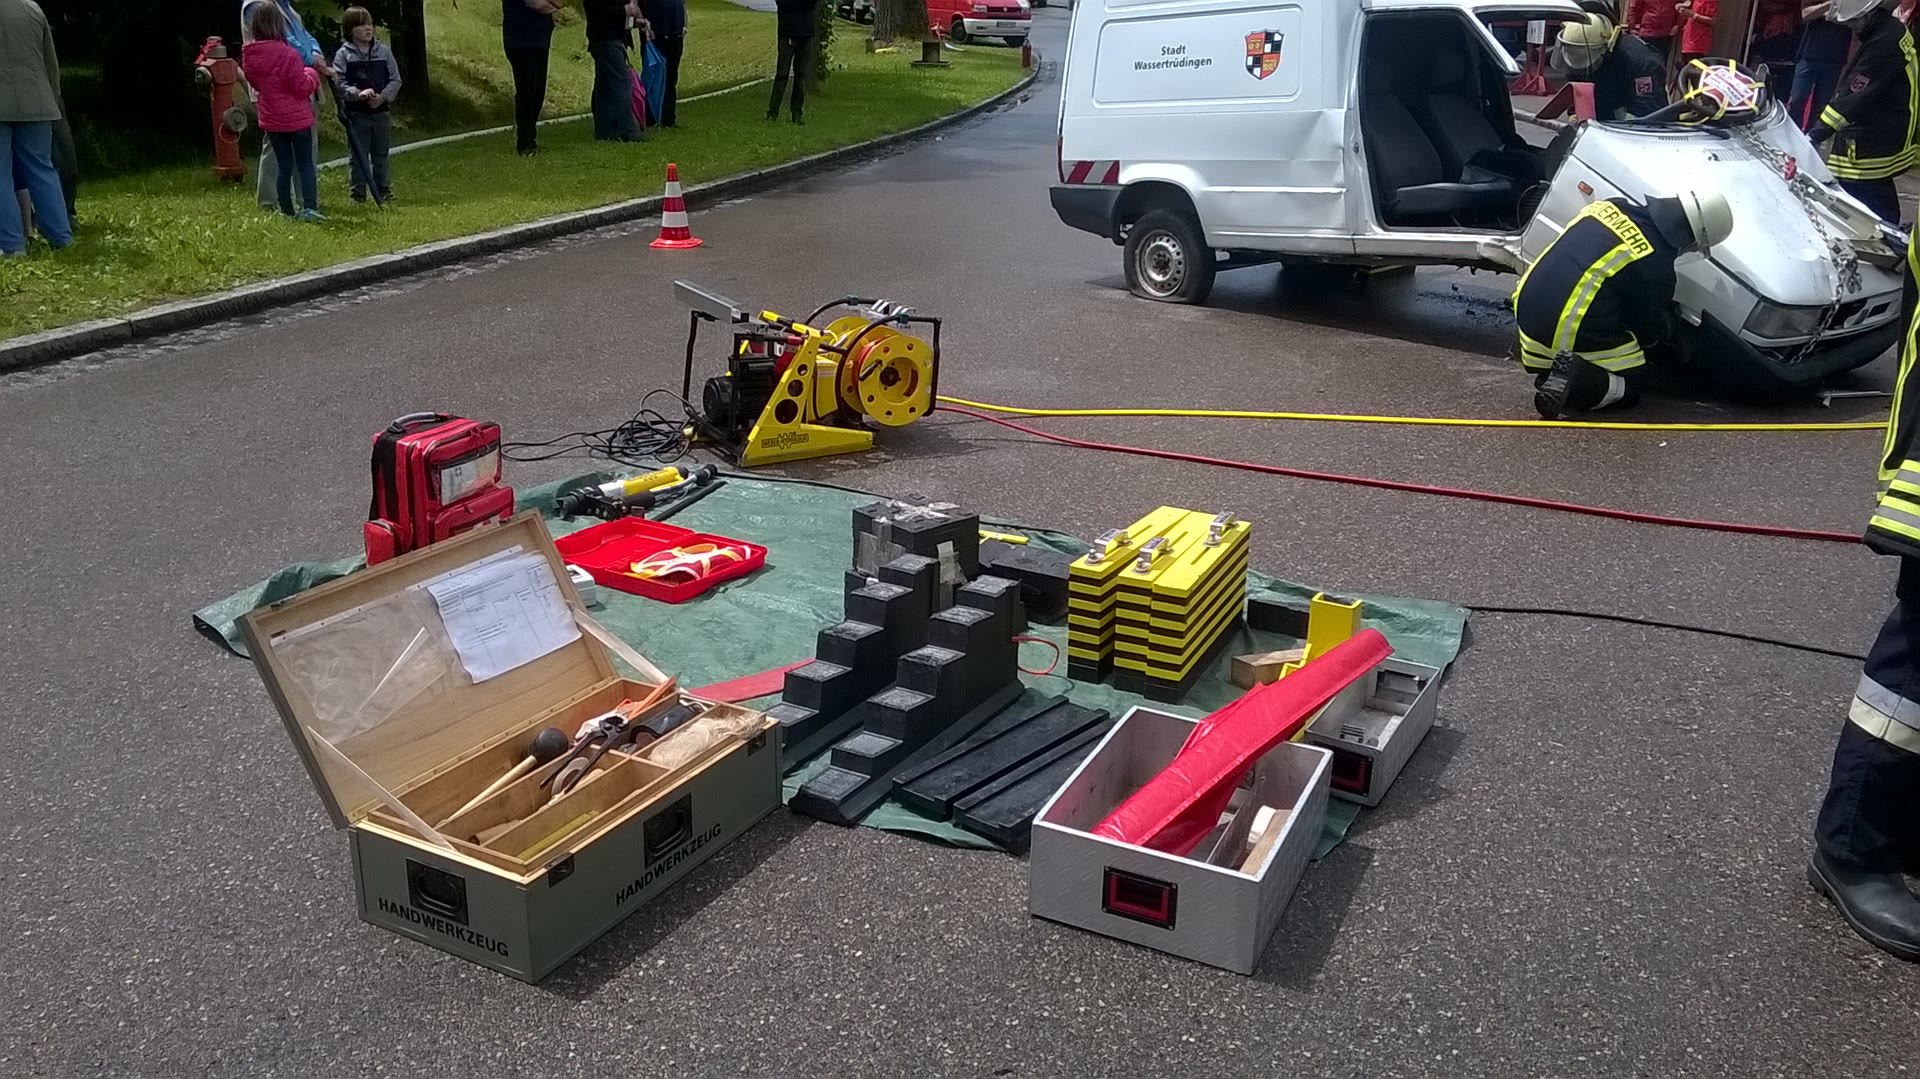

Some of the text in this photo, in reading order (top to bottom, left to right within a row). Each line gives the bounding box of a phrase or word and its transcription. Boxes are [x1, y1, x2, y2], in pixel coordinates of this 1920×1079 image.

[1134, 57, 1212, 71] Wassertrüdingen
[1160, 44, 1186, 56] Stadt
[615, 823, 722, 906] HANDWERKZEUG
[378, 897, 509, 957] HANDWERKZEUG
